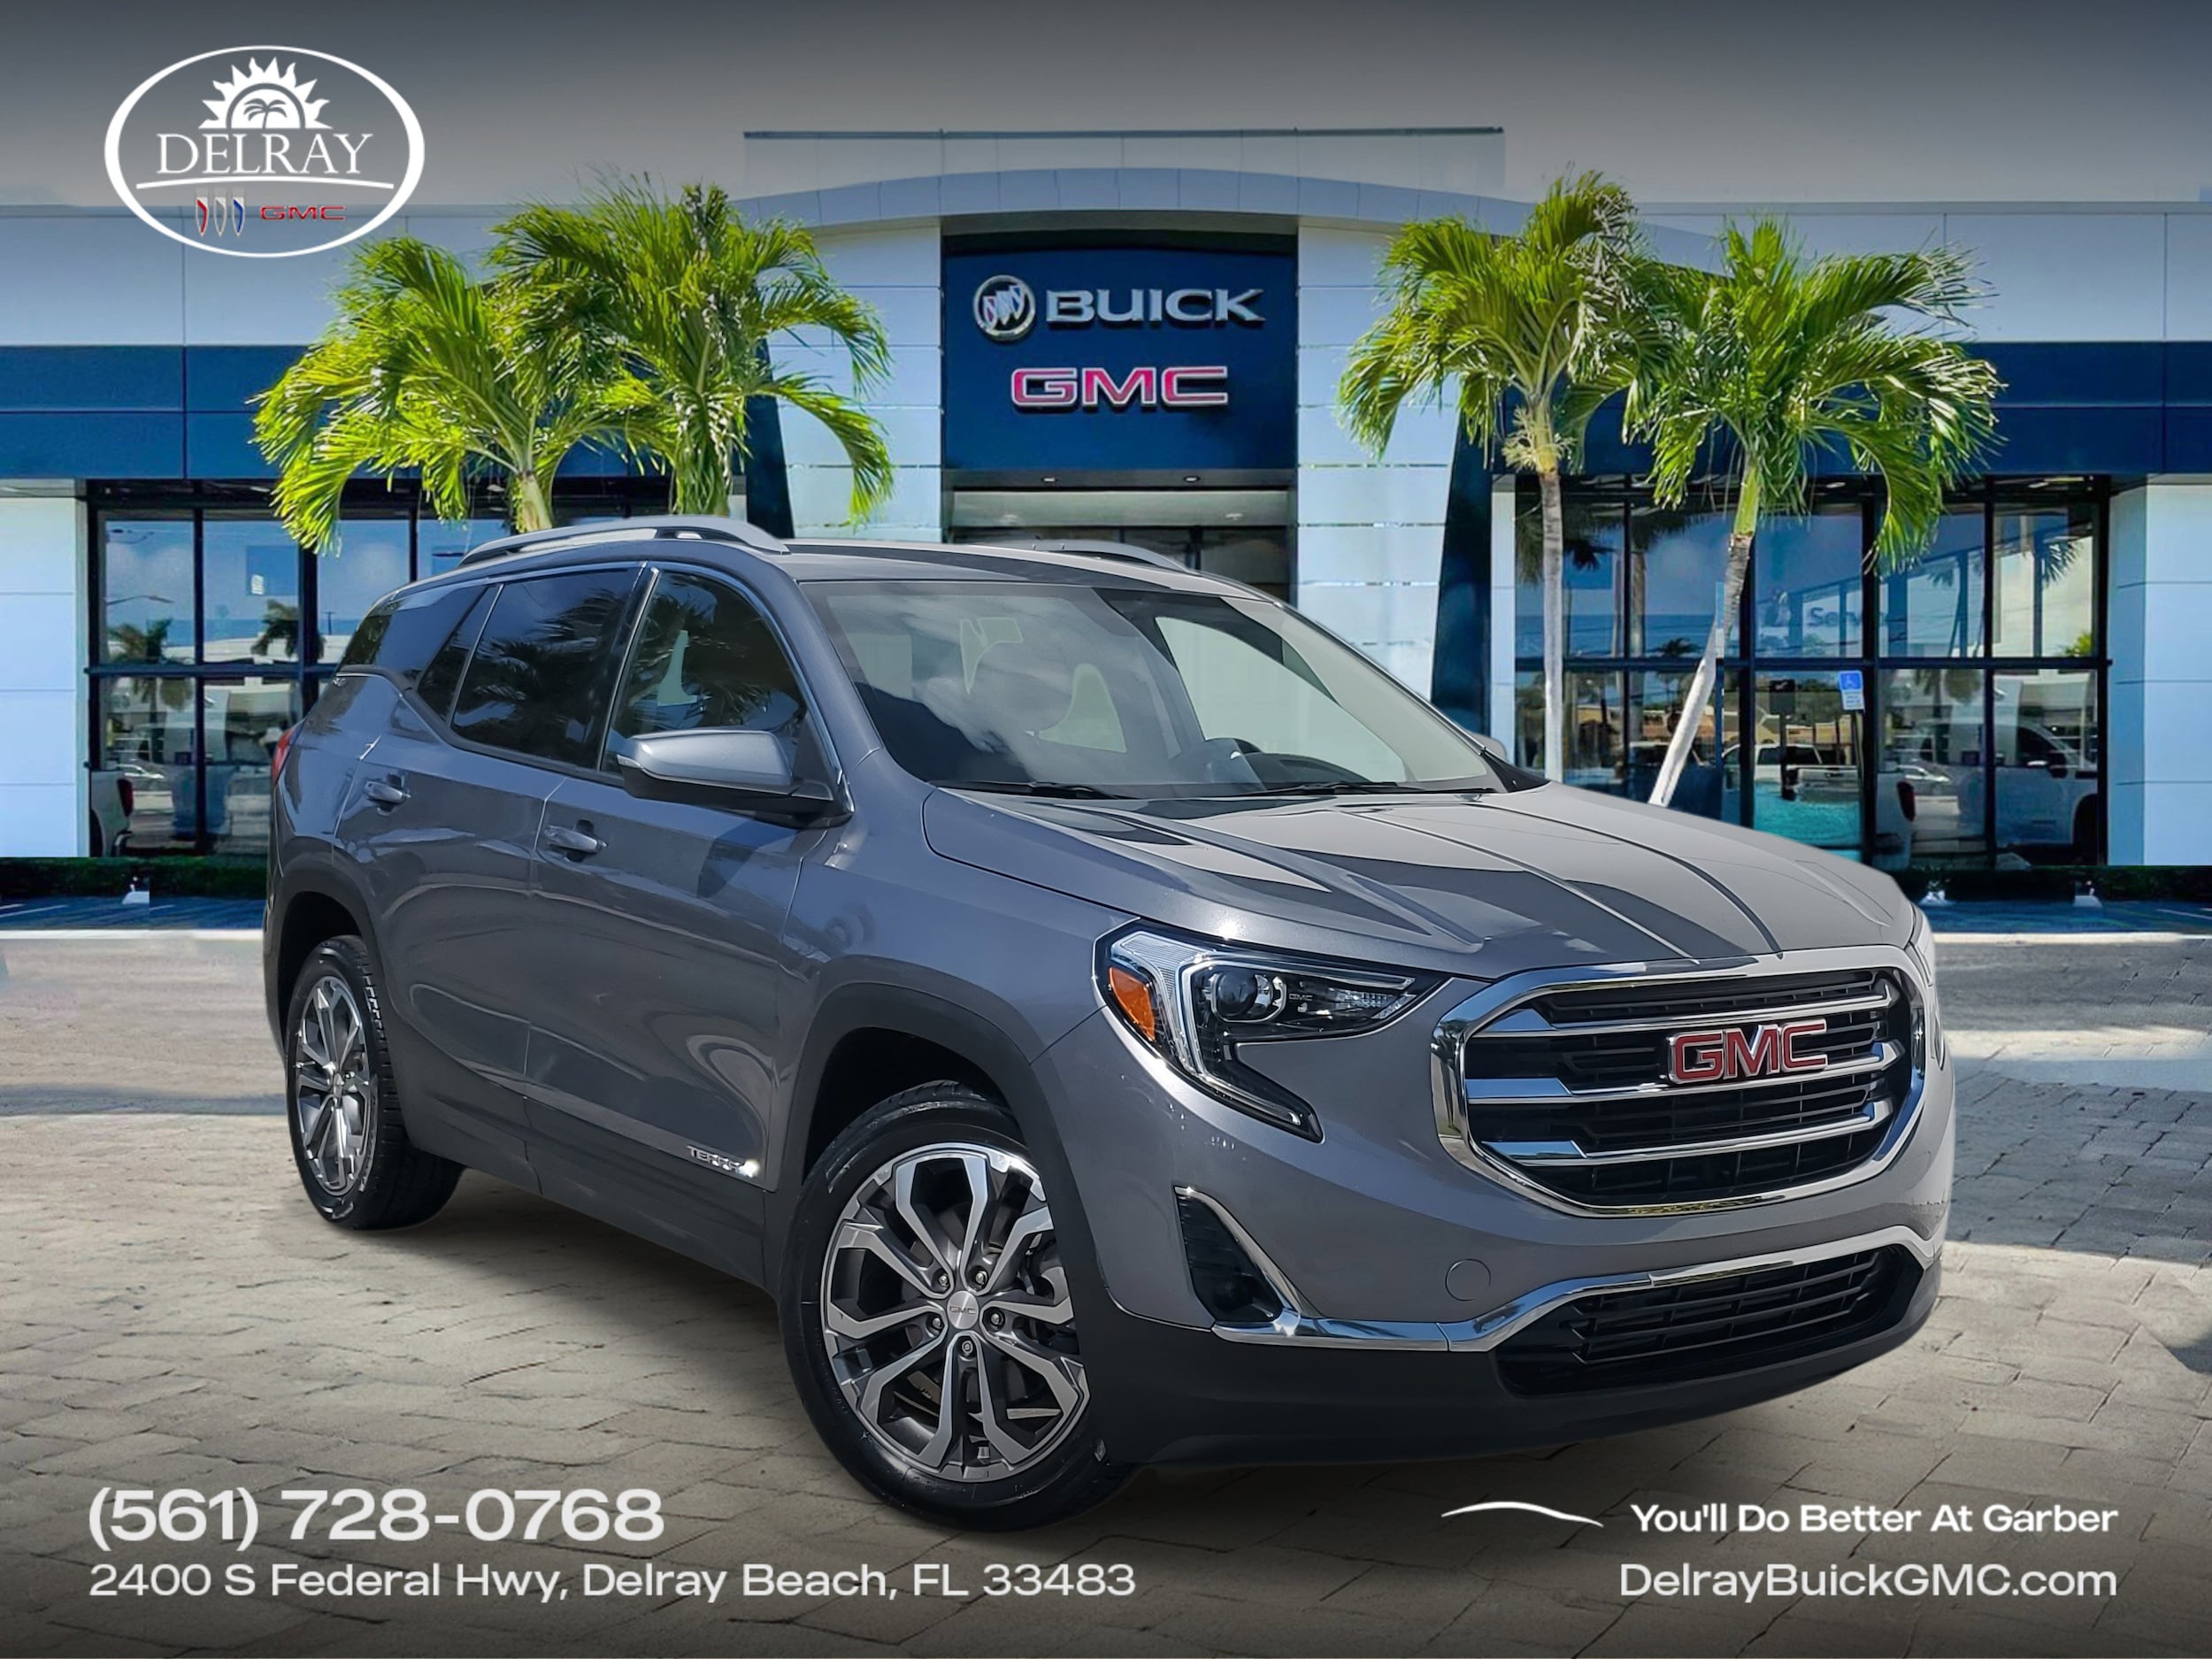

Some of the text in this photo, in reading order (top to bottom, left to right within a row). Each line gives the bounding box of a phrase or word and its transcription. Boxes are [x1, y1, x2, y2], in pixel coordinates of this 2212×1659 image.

[1046, 288, 1265, 323] BUICK
[1011, 365, 1229, 408] GMC
[1668, 1018, 1829, 1085] GMC
